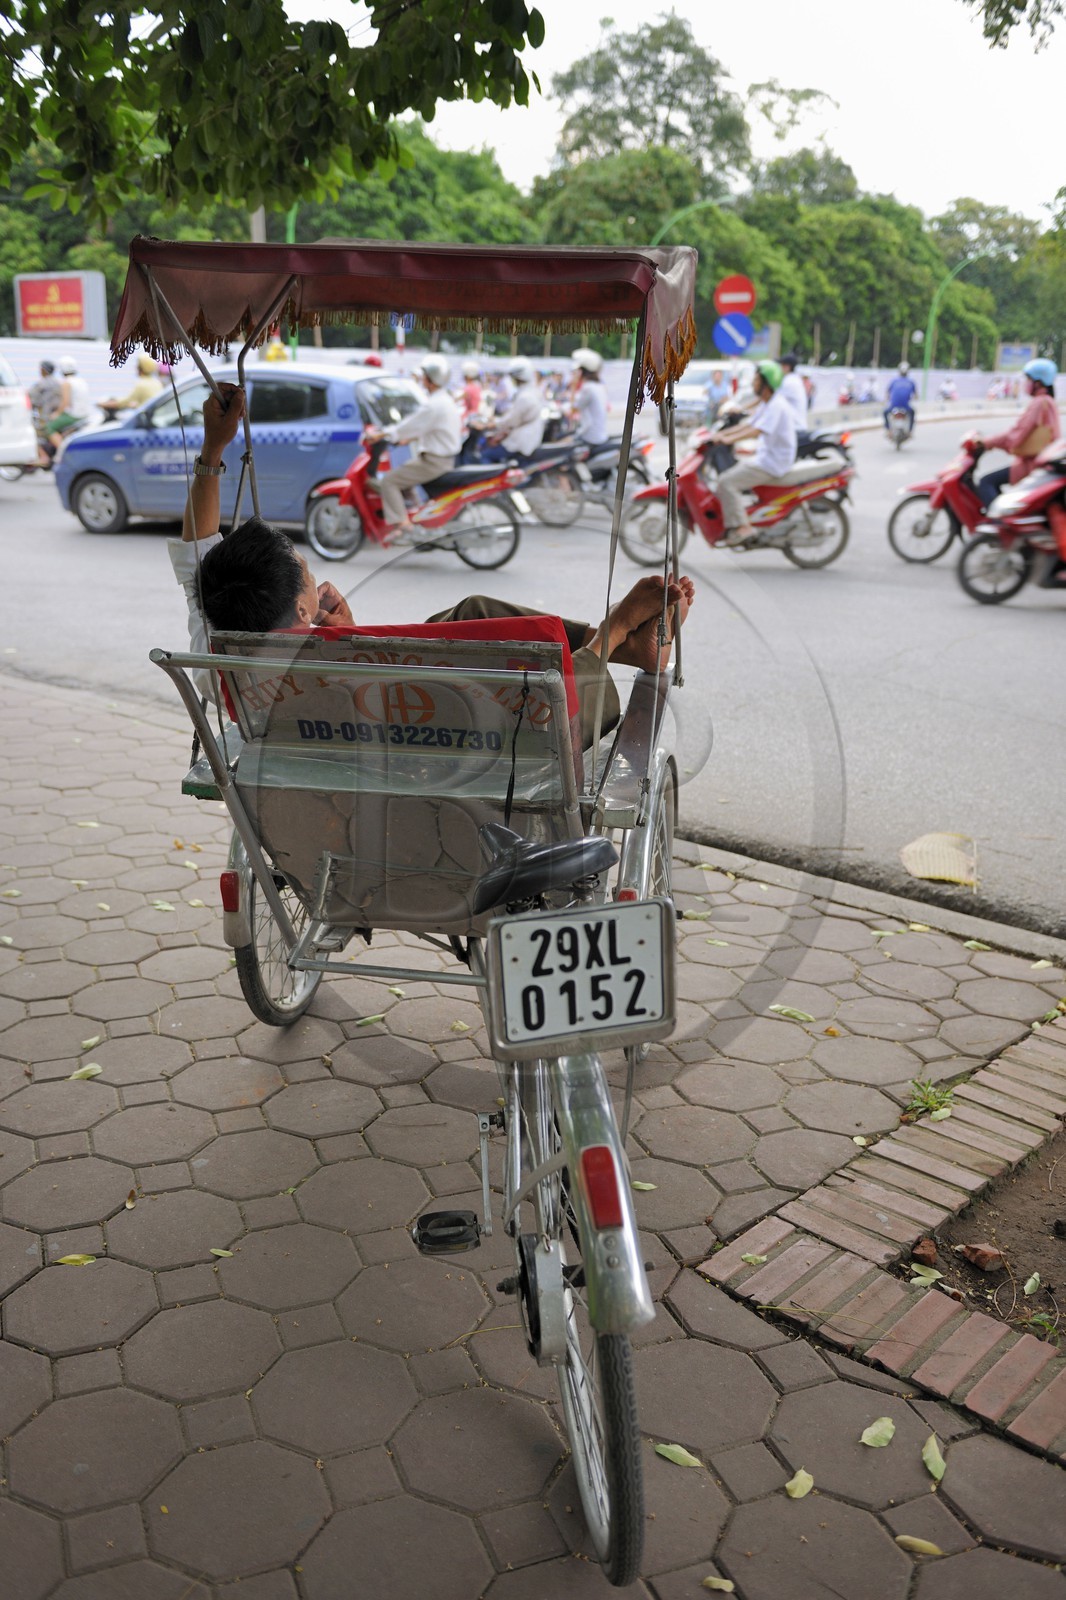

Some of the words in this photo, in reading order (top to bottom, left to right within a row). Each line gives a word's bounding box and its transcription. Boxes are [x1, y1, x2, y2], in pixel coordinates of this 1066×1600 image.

[240, 674, 304, 712] HUY
[297, 719, 502, 751] DĐ-0913226730
[530, 919, 632, 977] 29XL
[521, 968, 647, 1031] 0152
